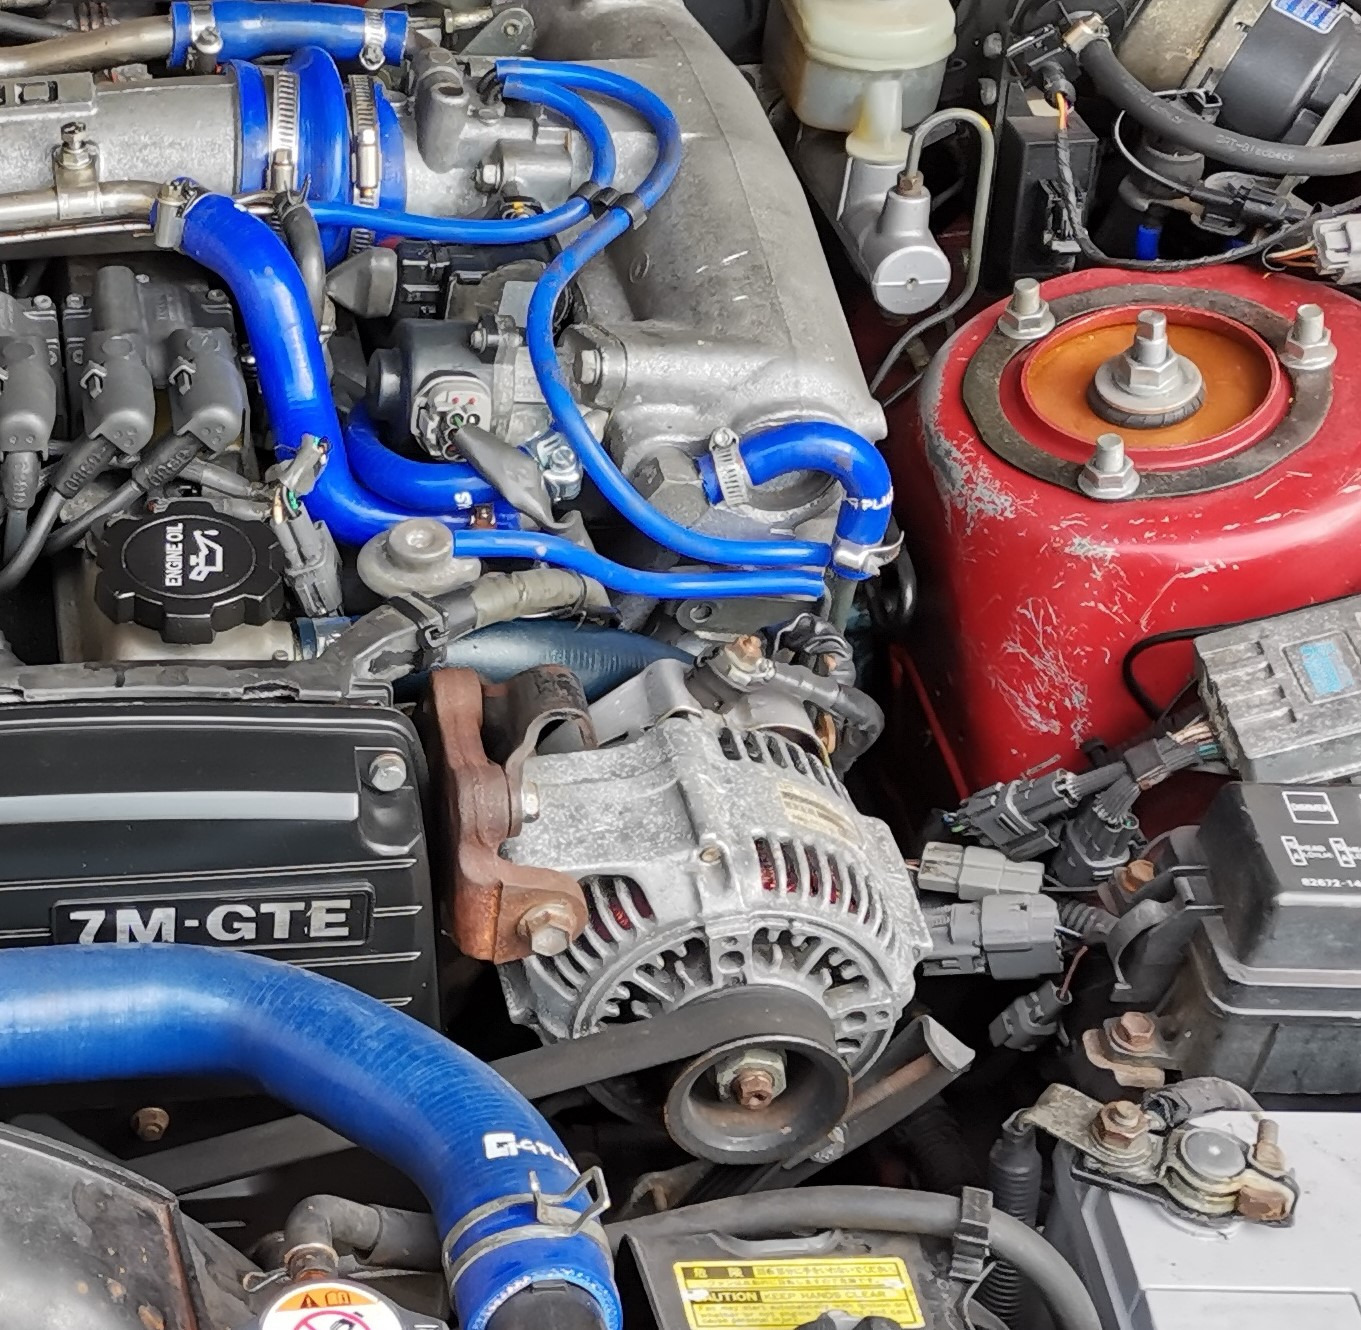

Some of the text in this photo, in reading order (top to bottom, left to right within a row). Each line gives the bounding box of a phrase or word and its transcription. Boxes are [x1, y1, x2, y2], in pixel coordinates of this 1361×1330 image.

[164, 522, 184, 587] ENGINE OIL
[69, 899, 351, 945] 7M-GTE
[697, 1290, 886, 1302] AUTION KEEP HANDS CLEAR
